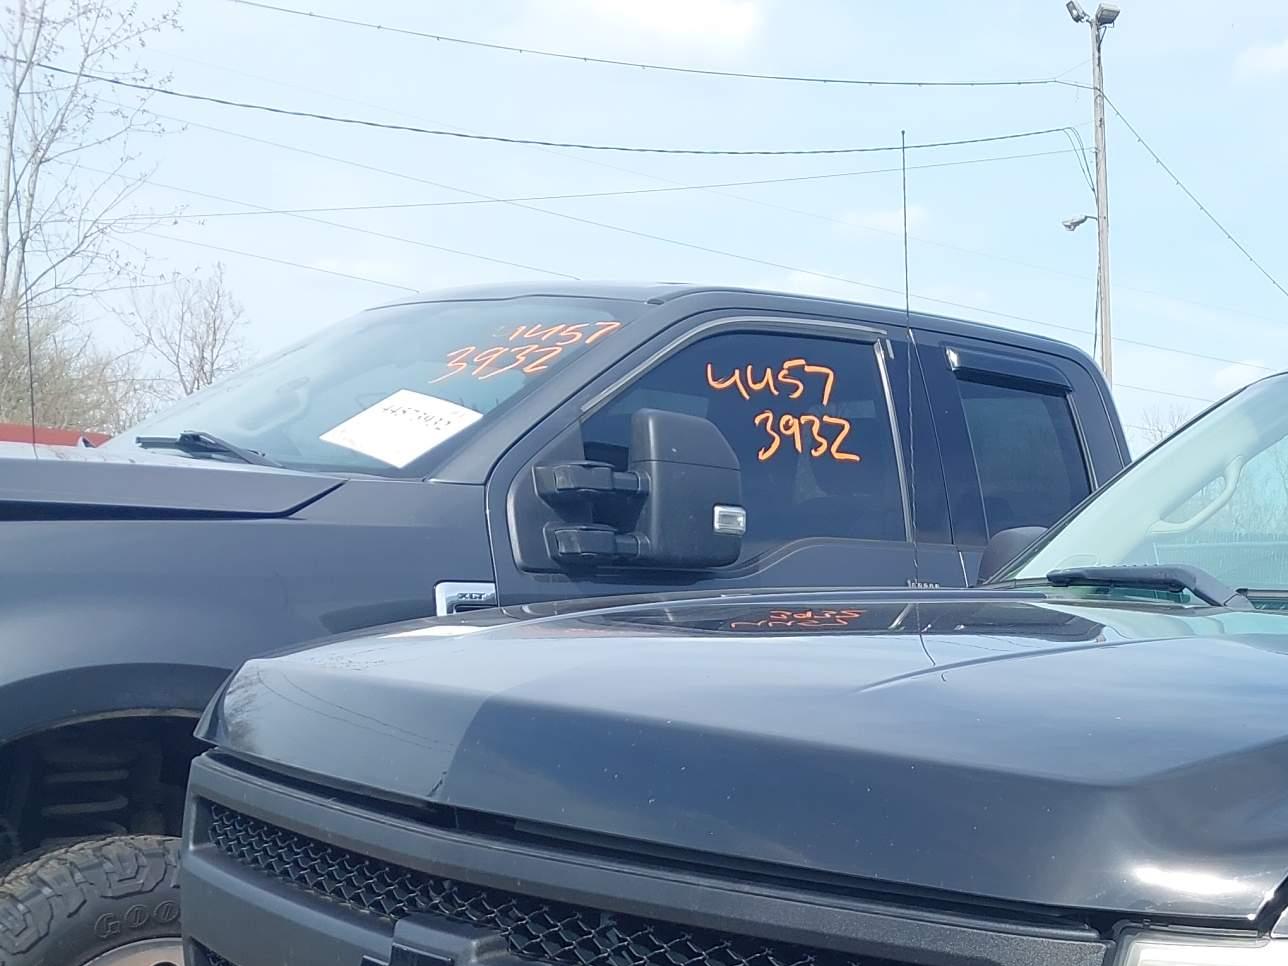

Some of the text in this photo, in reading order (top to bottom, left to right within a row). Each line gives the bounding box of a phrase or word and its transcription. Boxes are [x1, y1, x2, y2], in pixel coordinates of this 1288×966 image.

[427, 344, 564, 384] 3932
[706, 357, 835, 406] 4457
[754, 409, 861, 462] 3932
[456, 592, 486, 601] XLT
